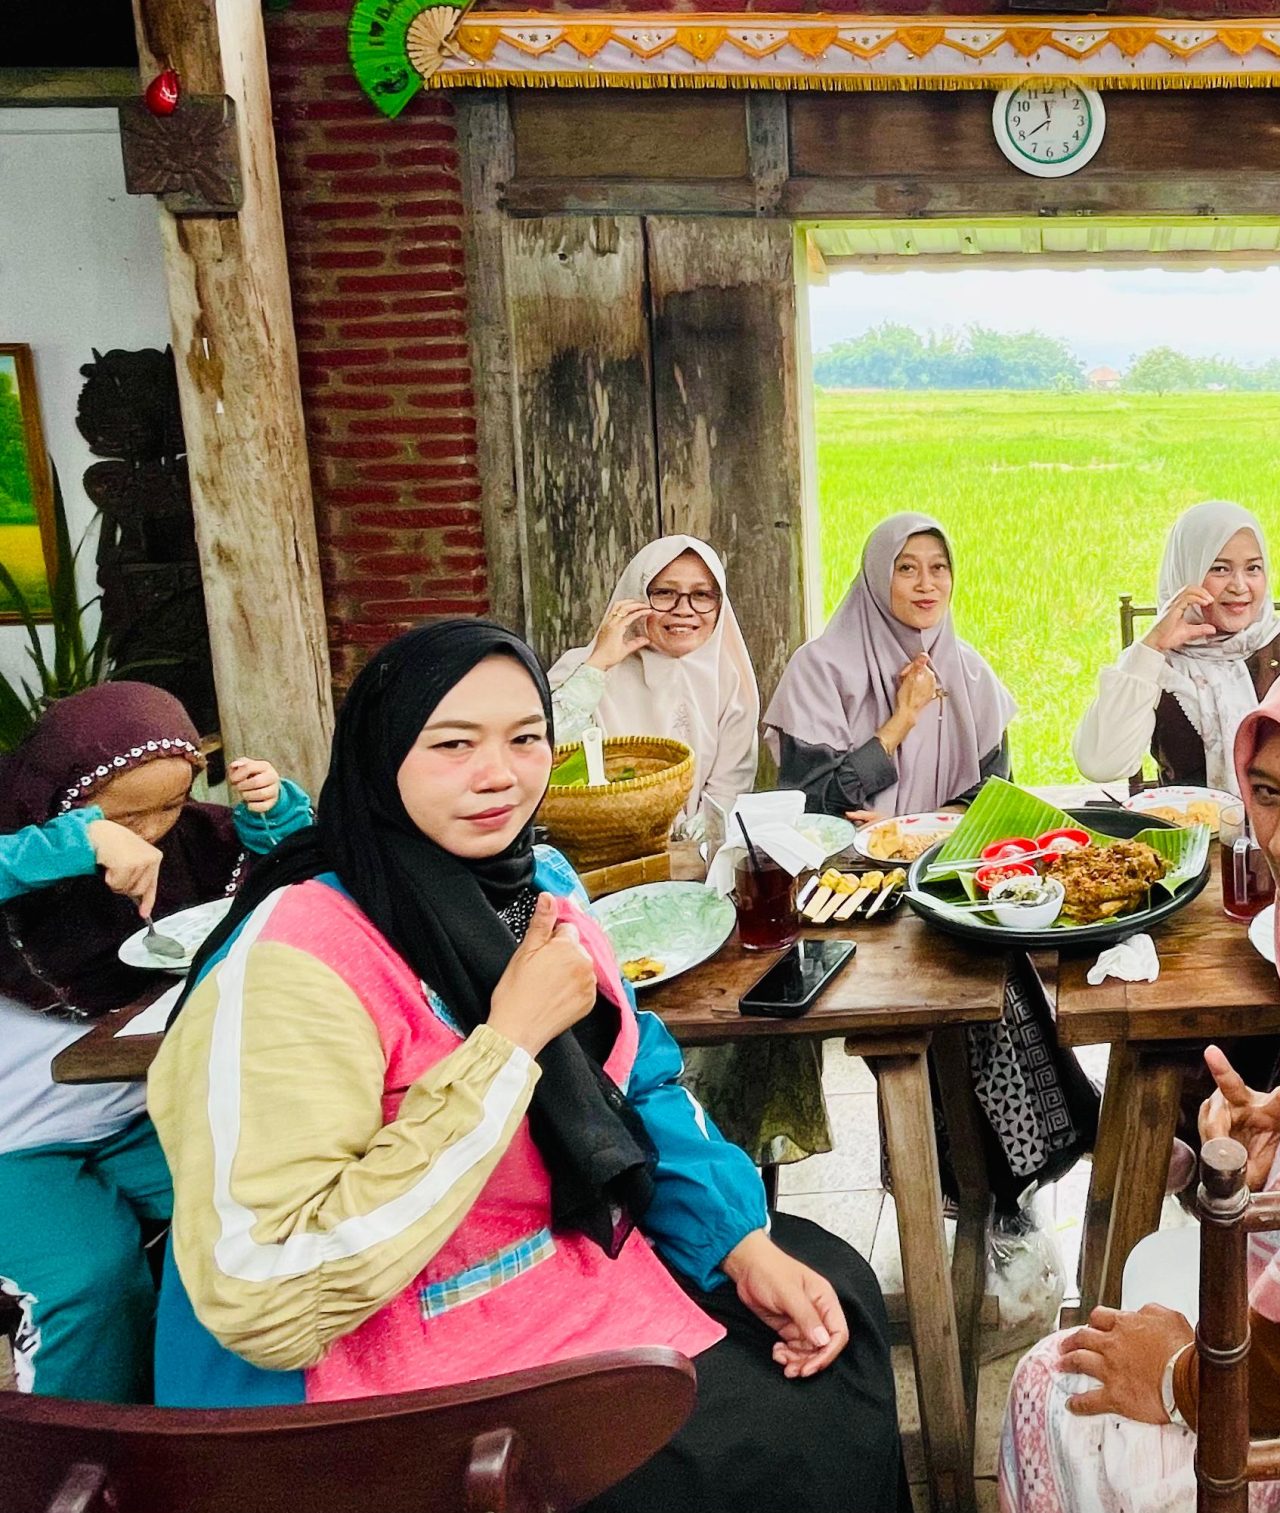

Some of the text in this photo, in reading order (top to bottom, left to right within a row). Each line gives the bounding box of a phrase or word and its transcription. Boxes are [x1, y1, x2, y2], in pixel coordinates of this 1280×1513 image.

[1028, 88, 1038, 99] 11
[1062, 87, 1066, 98] 1
[1017, 101, 1030, 112] 10
[1072, 99, 1080, 110] 2
[1013, 116, 1021, 127] 9
[1077, 115, 1084, 127] 3
[1018, 130, 1026, 141] 8
[1072, 130, 1079, 141] 4
[1031, 143, 1038, 153] 7
[1046, 147, 1053, 157] 6
[1063, 142, 1069, 153] 5
